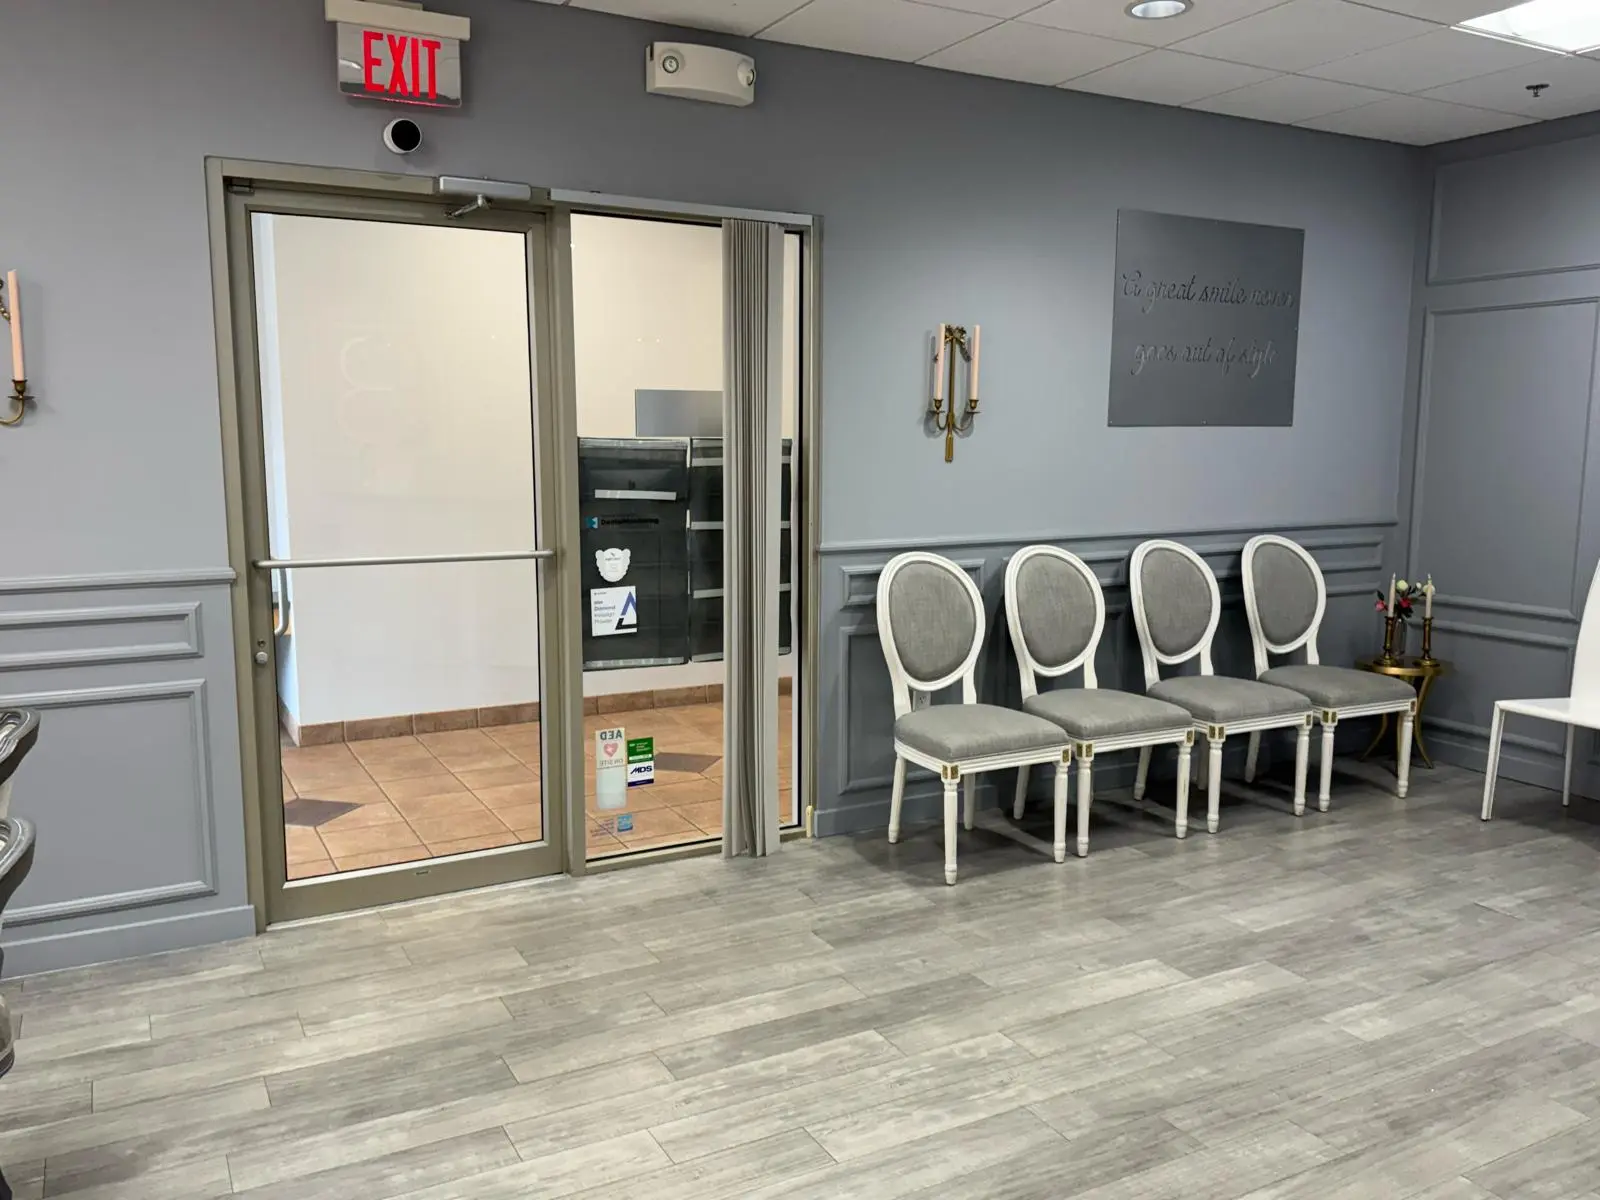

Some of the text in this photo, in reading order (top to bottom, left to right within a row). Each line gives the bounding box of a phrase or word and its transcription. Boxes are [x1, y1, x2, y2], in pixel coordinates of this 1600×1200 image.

[363, 30, 441, 100] EXIT
[1142, 274, 1197, 315] great
[1197, 278, 1248, 306] smile
[1248, 288, 1297, 309] never
[1130, 337, 1280, 380] goes out of style
